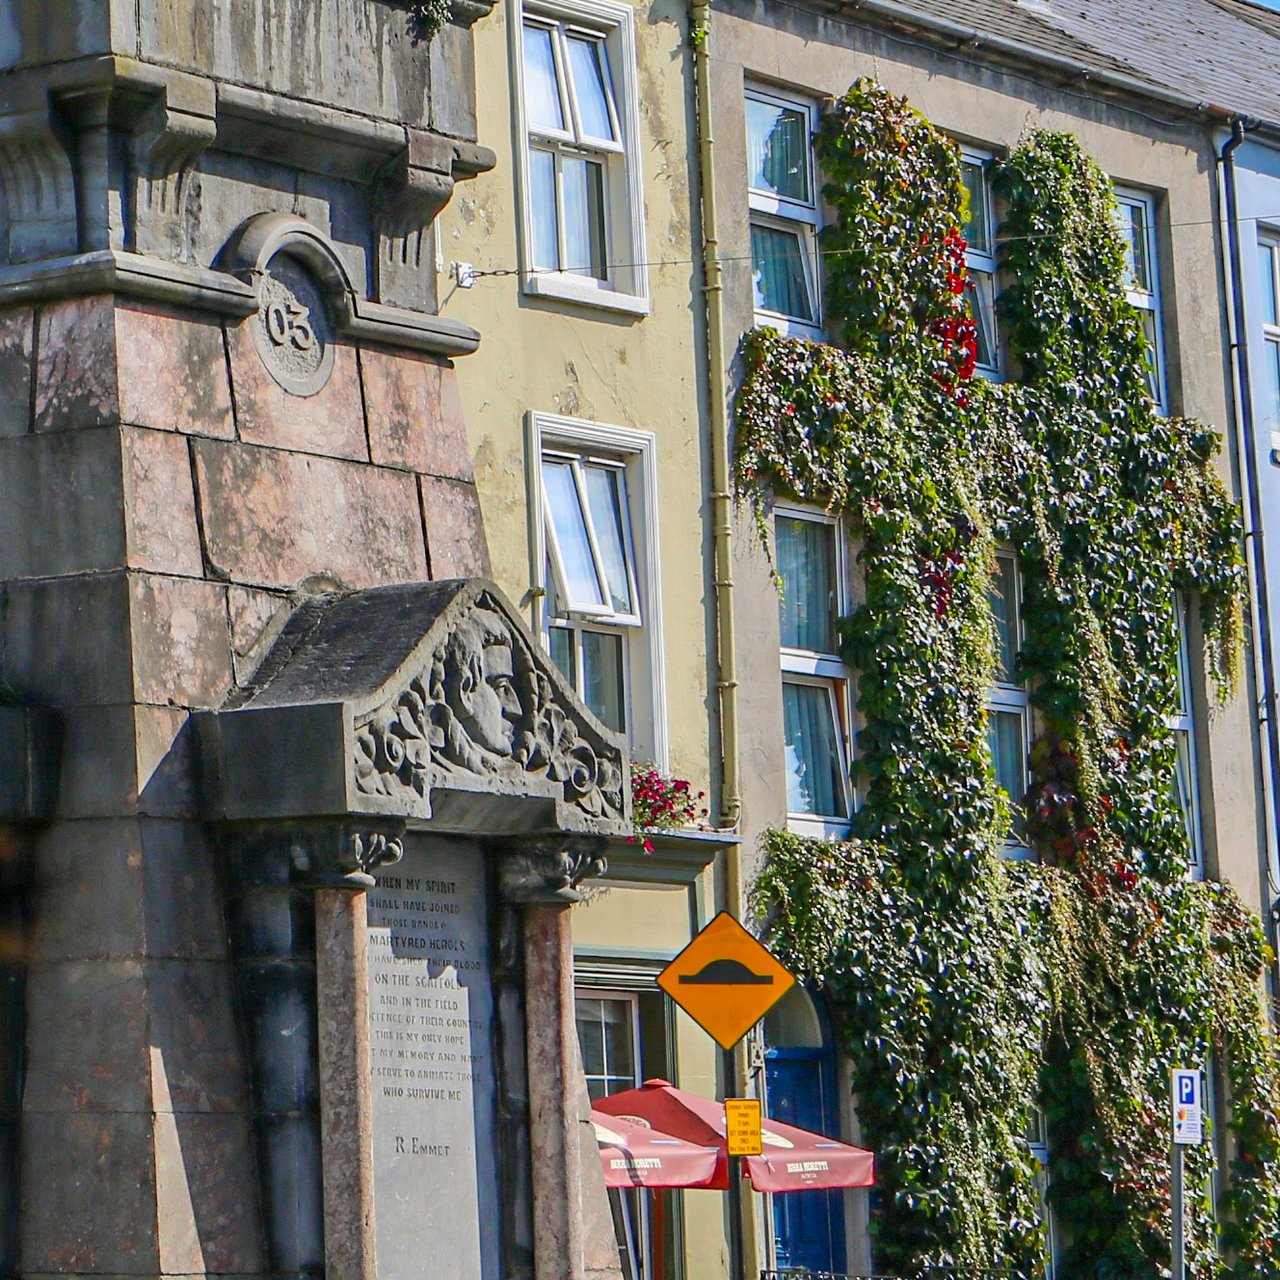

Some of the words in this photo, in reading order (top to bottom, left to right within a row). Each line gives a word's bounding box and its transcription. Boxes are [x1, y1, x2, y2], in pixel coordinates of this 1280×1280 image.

[266, 303, 315, 351] 03
[406, 878, 420, 891] MY
[425, 879, 456, 895] SPIRIT
[370, 898, 400, 910] SHALL
[403, 900, 427, 912] HAVE
[369, 934, 427, 949] MARTYRED
[375, 973, 389, 984] ON
[392, 974, 411, 987] THE
[380, 995, 399, 1007] AND
[402, 996, 413, 1008] IN
[416, 998, 433, 1009] THE
[383, 1086, 404, 1098] WHO
[406, 1088, 445, 1100] SURVIVE
[448, 1089, 462, 1101] ME
[1181, 1077, 1192, 1102] P
